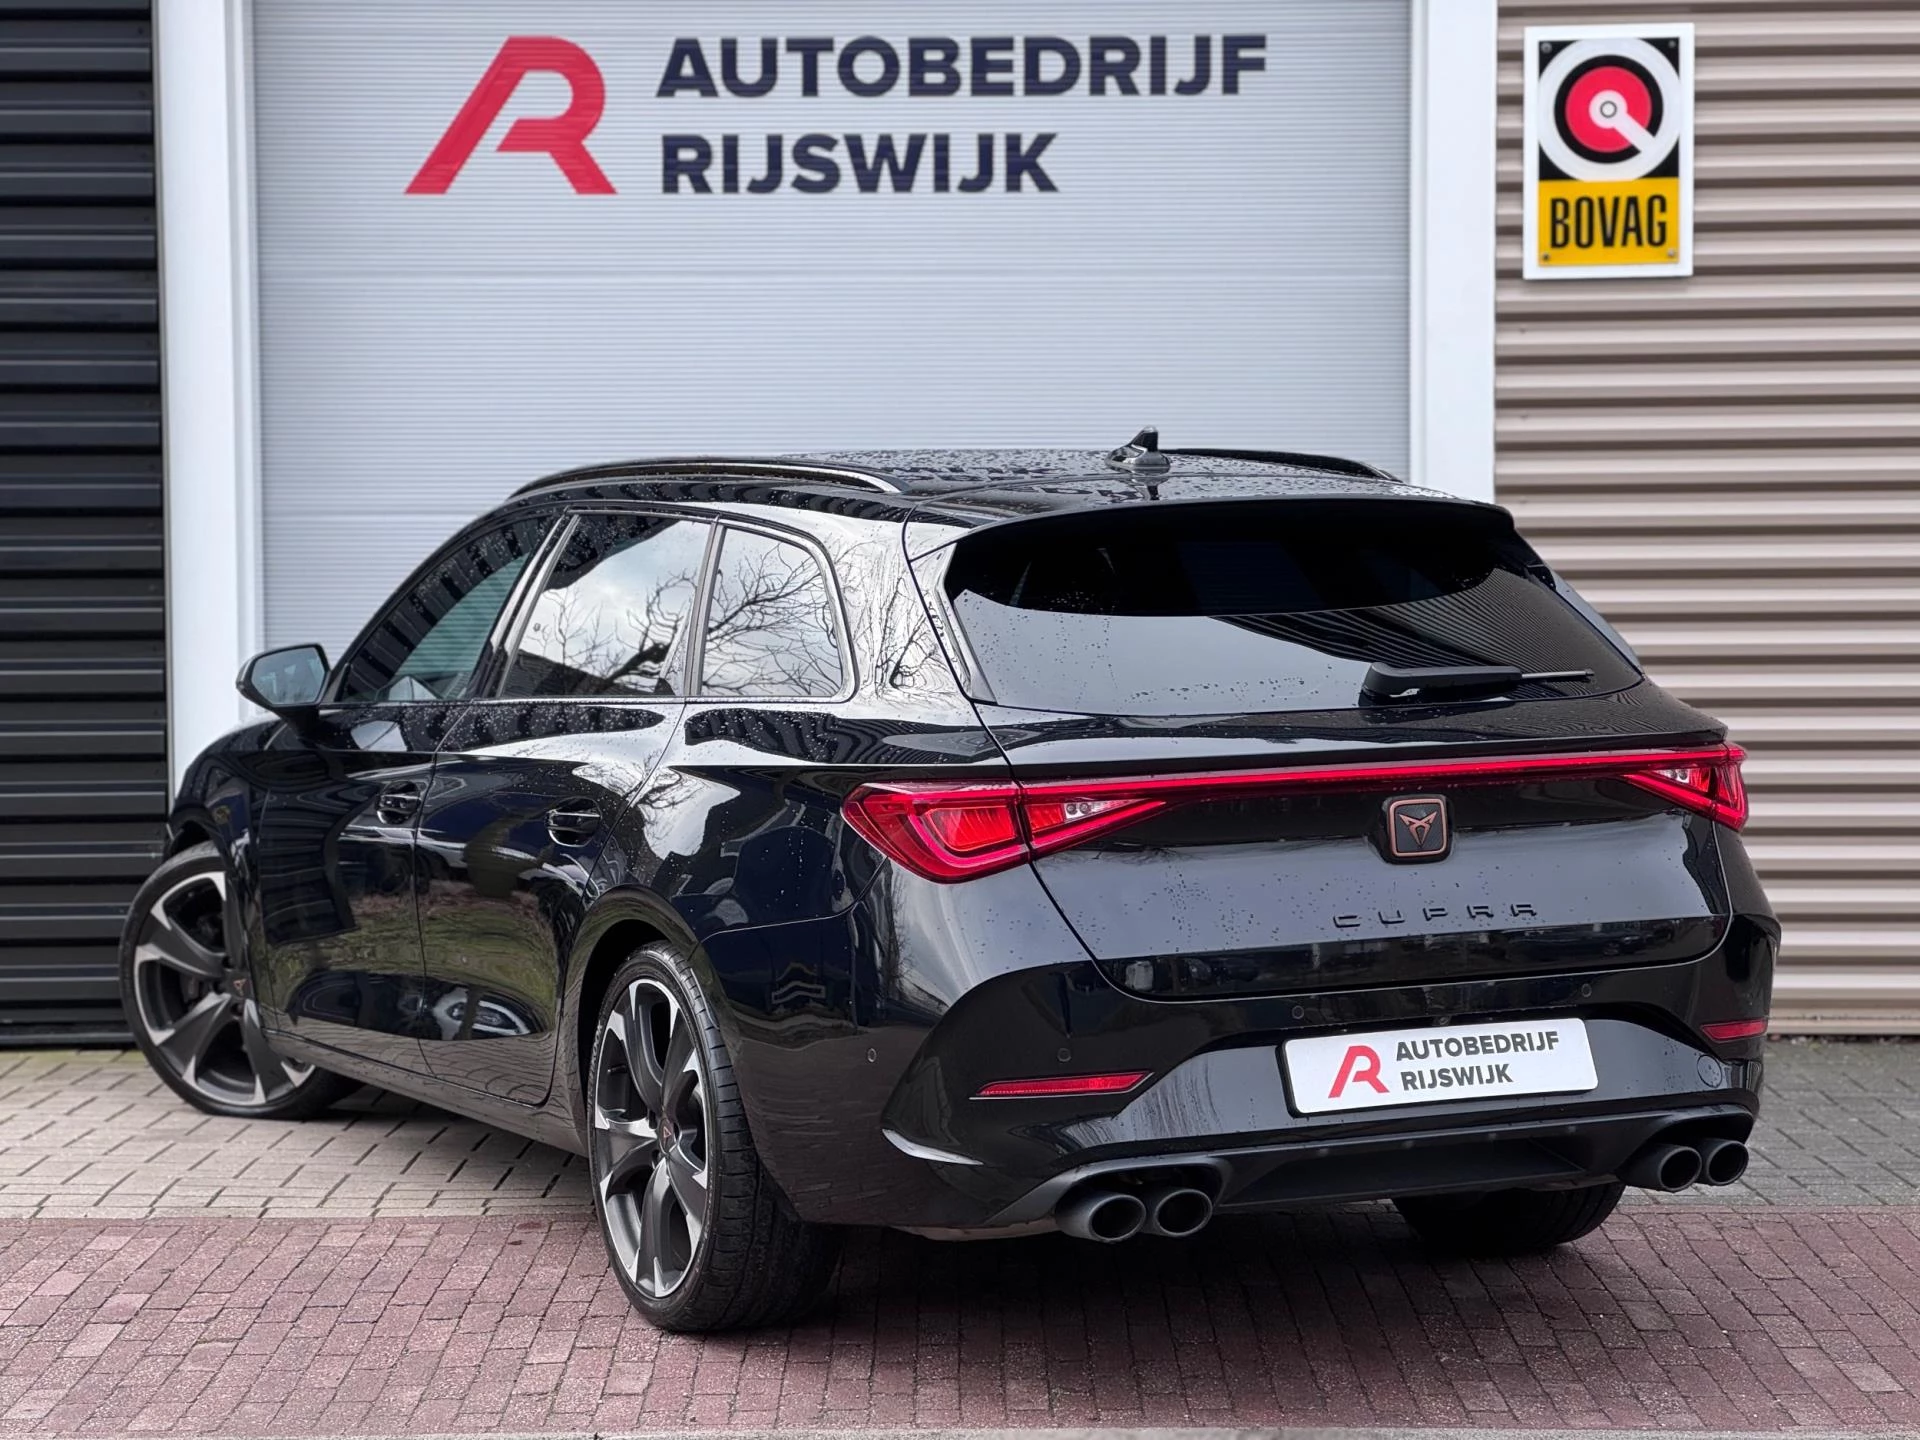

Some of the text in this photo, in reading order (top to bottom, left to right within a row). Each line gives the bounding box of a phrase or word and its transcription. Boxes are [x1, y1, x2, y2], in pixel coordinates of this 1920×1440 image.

[656, 34, 1268, 98] AUTOBEDRIJF
[661, 132, 1060, 195] RIJSWIJK
[1550, 194, 1668, 249] BOVAG
[1332, 903, 1538, 929] CUPRA
[1396, 1030, 1560, 1061] AUTOBEDRIJF
[1401, 1063, 1514, 1091] RIJSWIJK
